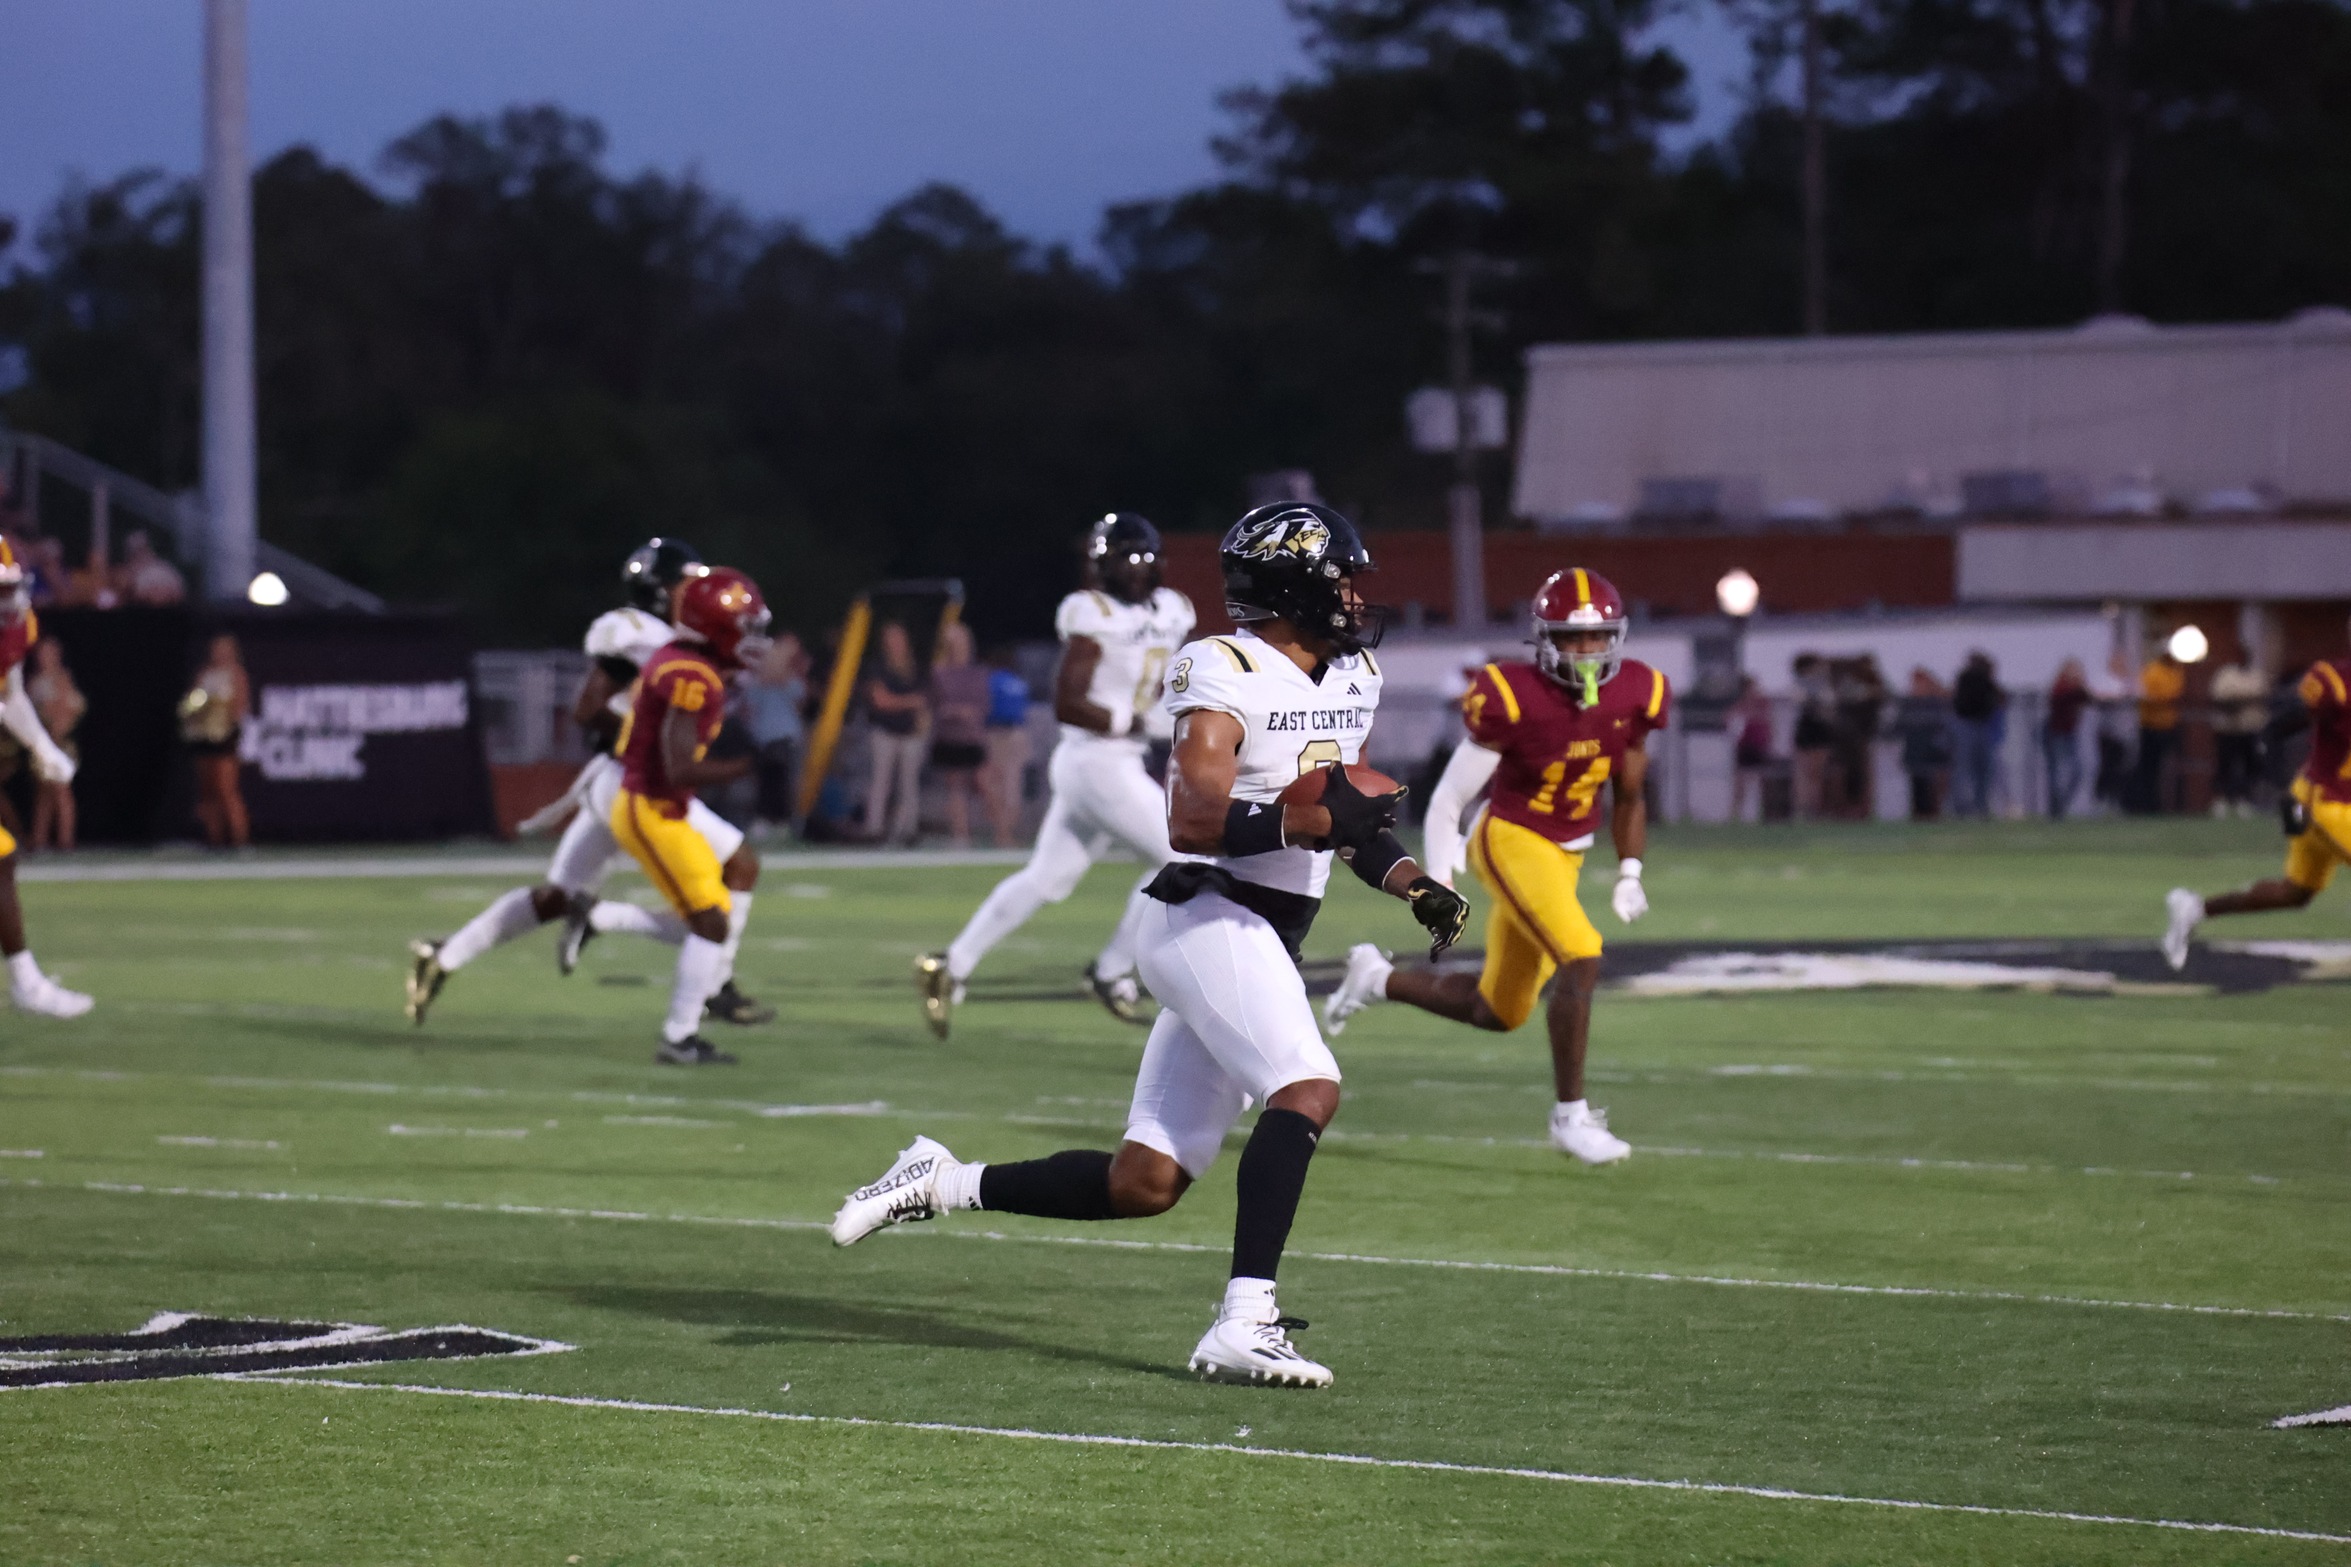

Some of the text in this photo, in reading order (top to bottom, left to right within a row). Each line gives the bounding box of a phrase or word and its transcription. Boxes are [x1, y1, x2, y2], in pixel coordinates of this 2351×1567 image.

[1171, 657, 1194, 693] 3
[671, 677, 708, 712] 16
[1267, 711, 1308, 731] EAST
[1528, 756, 1612, 821] 14
